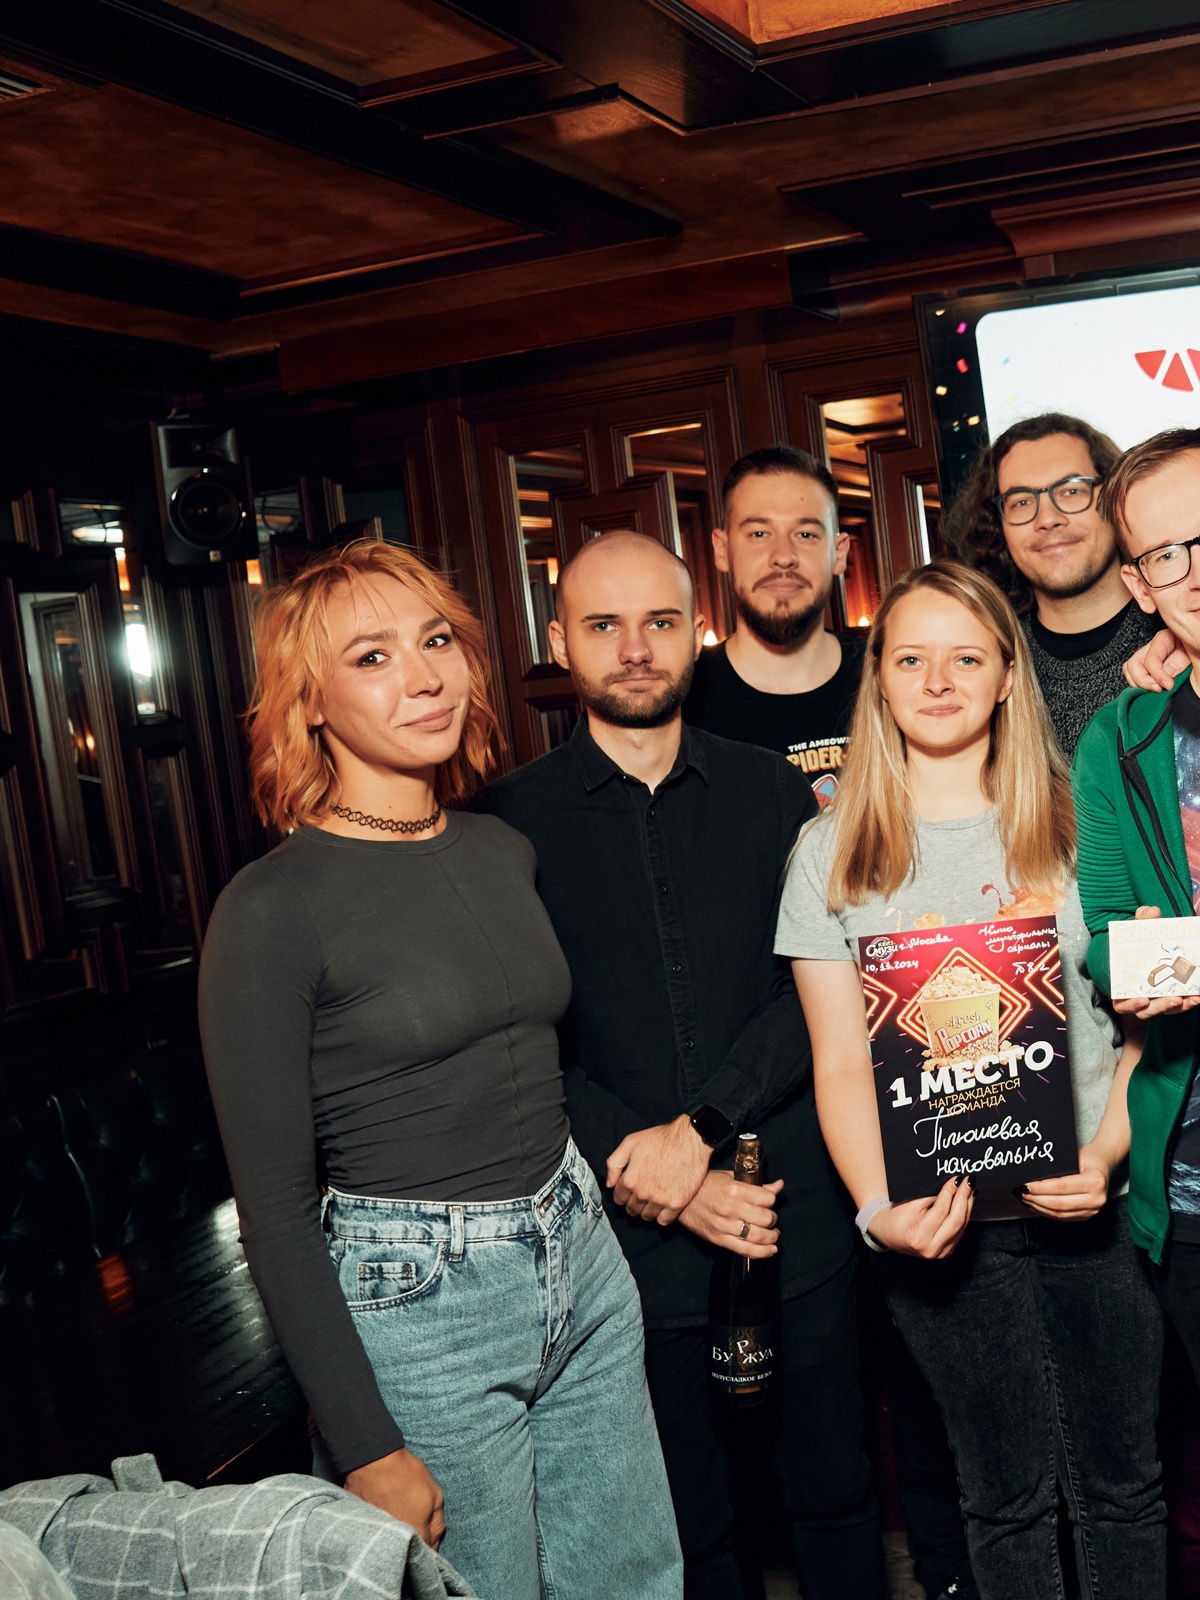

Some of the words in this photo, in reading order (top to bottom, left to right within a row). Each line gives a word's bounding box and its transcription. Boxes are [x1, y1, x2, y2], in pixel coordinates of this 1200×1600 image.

[788, 742, 808, 753] THE
[908, 933, 953, 948] Москва
[1007, 941, 1051, 954] сериалы
[866, 944, 898, 958] Смузи
[890, 1077, 913, 1108] 1
[920, 1040, 1054, 1101] МЕСТО
[929, 1077, 1021, 1110] НАГРАЖДАЕТСЯ
[947, 1095, 1007, 1115] КОМАНДА
[914, 1103, 1042, 1158] Плюшевая
[937, 1141, 1054, 1176] наковальня
[711, 1371, 756, 1383] ПОЛУСЛАДКОЕ
